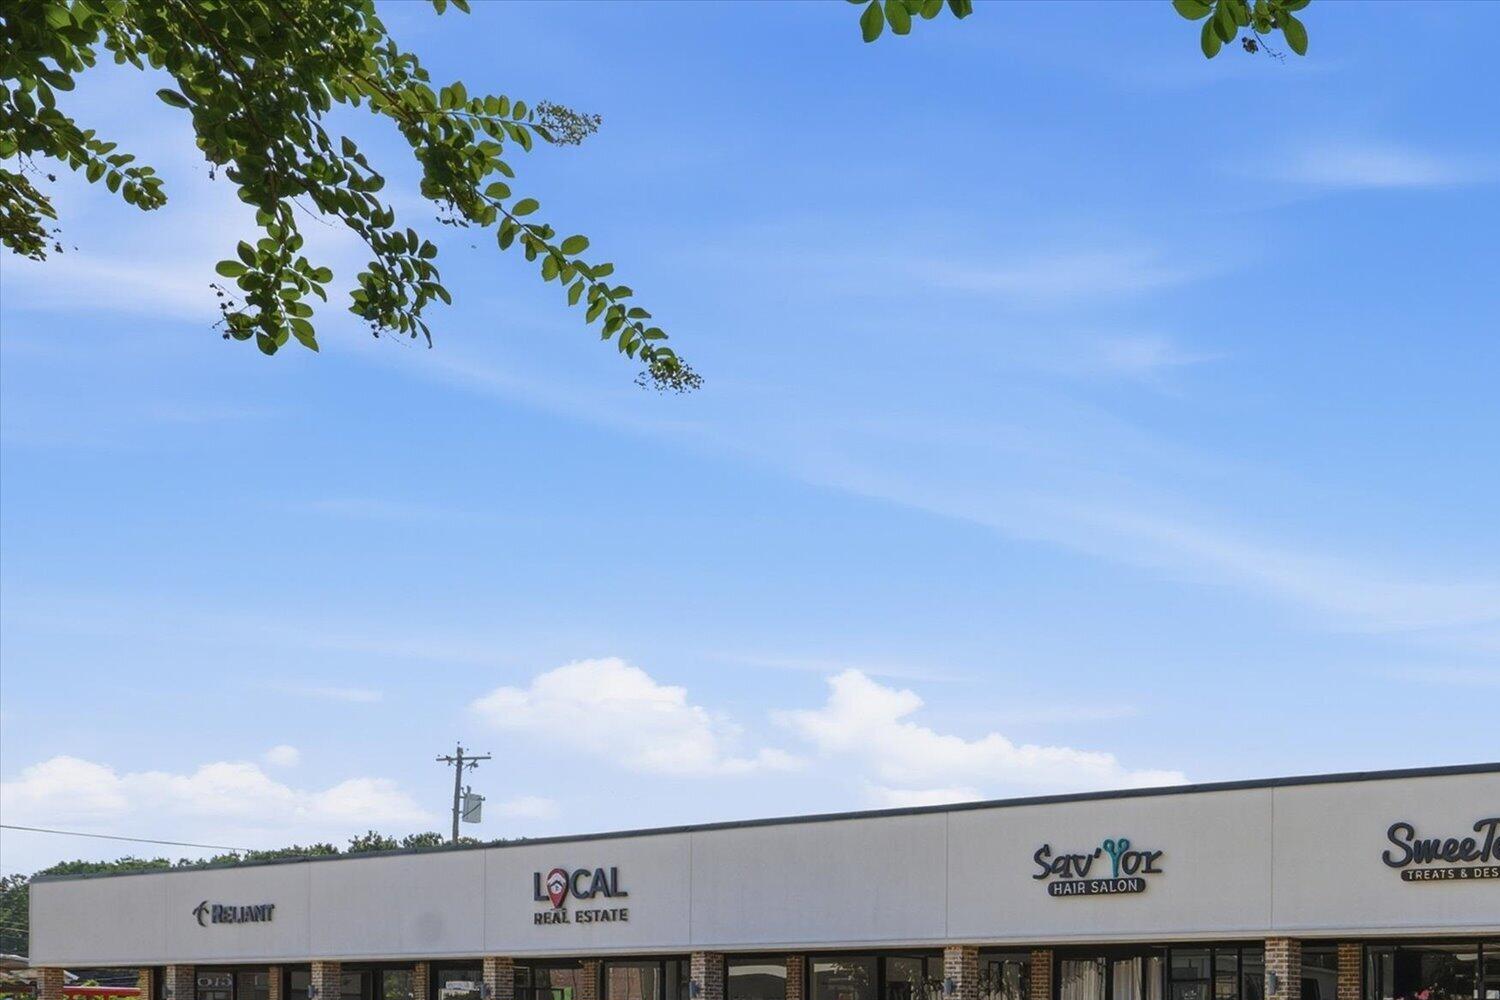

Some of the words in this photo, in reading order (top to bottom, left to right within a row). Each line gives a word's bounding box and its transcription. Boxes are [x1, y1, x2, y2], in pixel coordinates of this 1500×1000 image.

[1407, 869, 1455, 880] TREATS
[1460, 868, 1468, 878] &
[533, 866, 629, 909] LOCAL
[1053, 883, 1086, 895] HAIR
[1091, 879, 1139, 893] SALON
[533, 910, 571, 925] REAL
[575, 908, 629, 923] ESTATE
